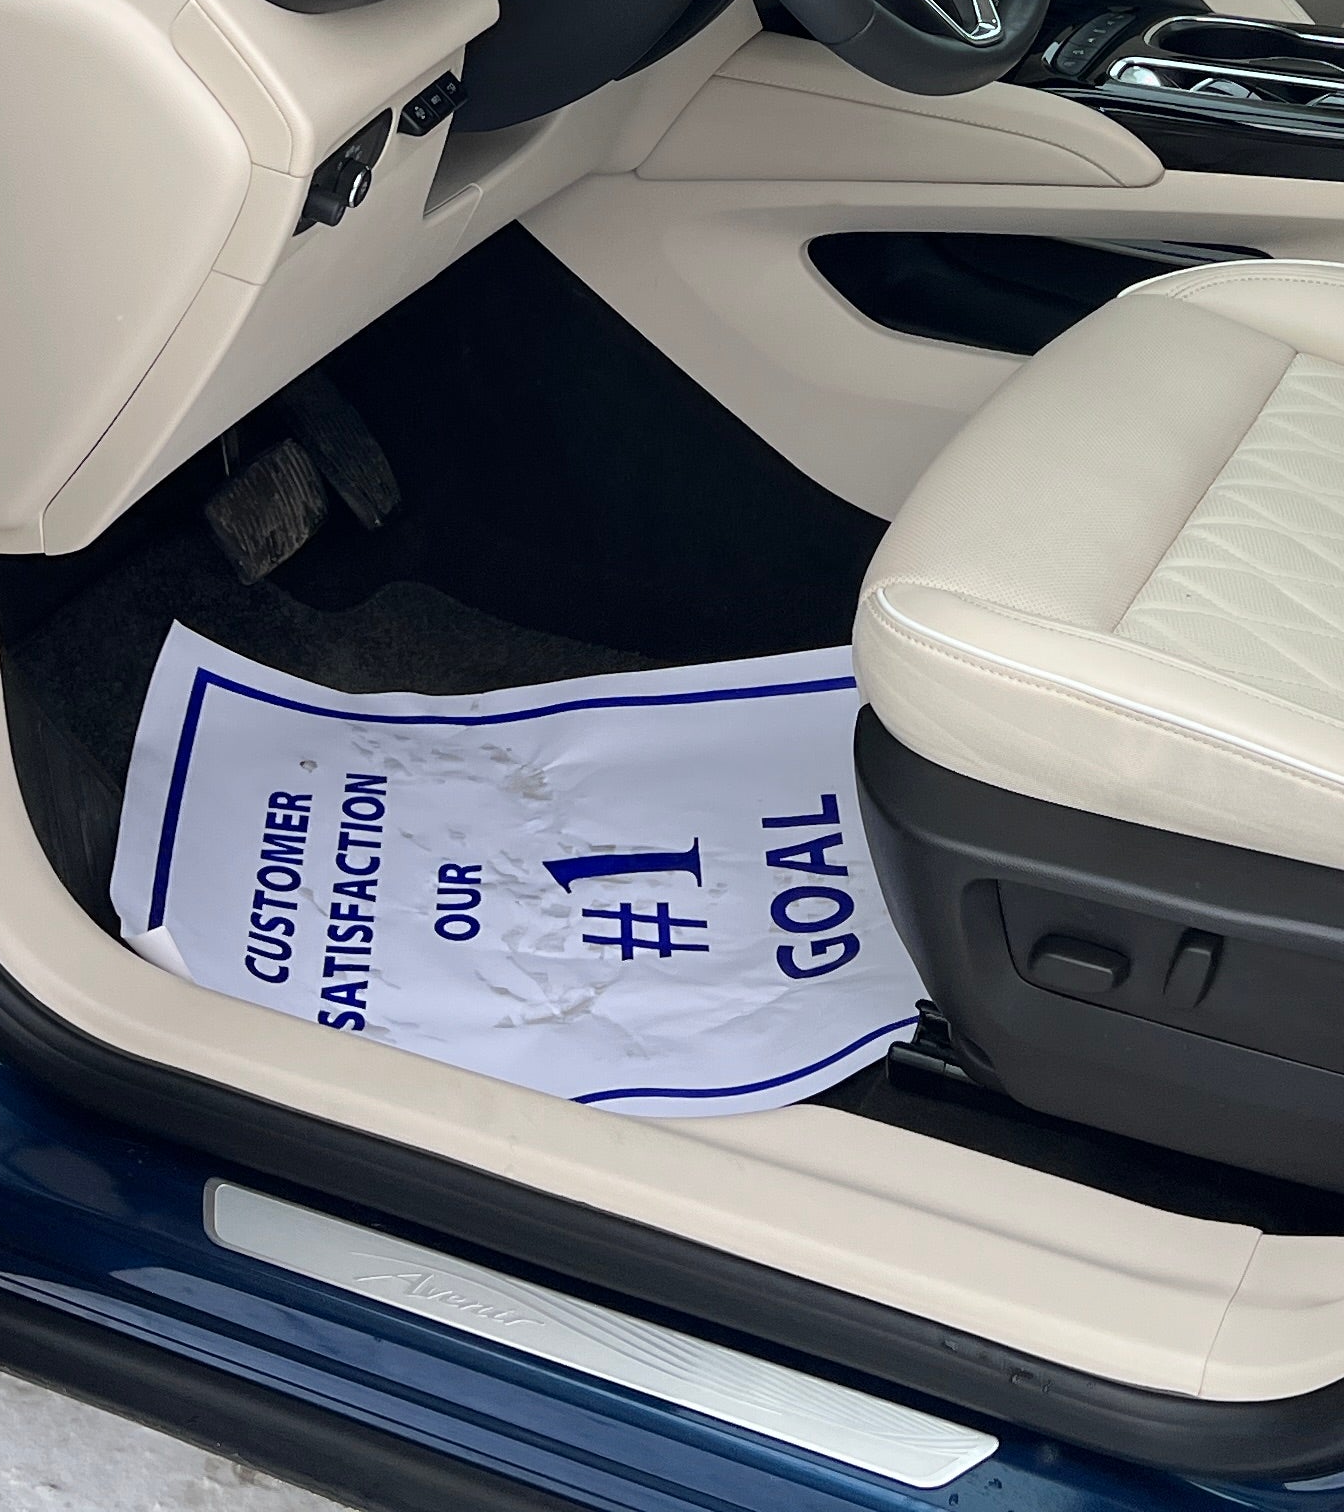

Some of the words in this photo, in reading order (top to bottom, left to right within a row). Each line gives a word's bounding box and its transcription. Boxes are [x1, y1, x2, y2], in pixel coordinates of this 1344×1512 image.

[244, 790, 313, 985] CUSTOMER
[317, 772, 388, 1032] SATISFACTION
[433, 862, 483, 942] OUR
[542, 836, 710, 961] #1
[760, 792, 860, 980] GOAL
